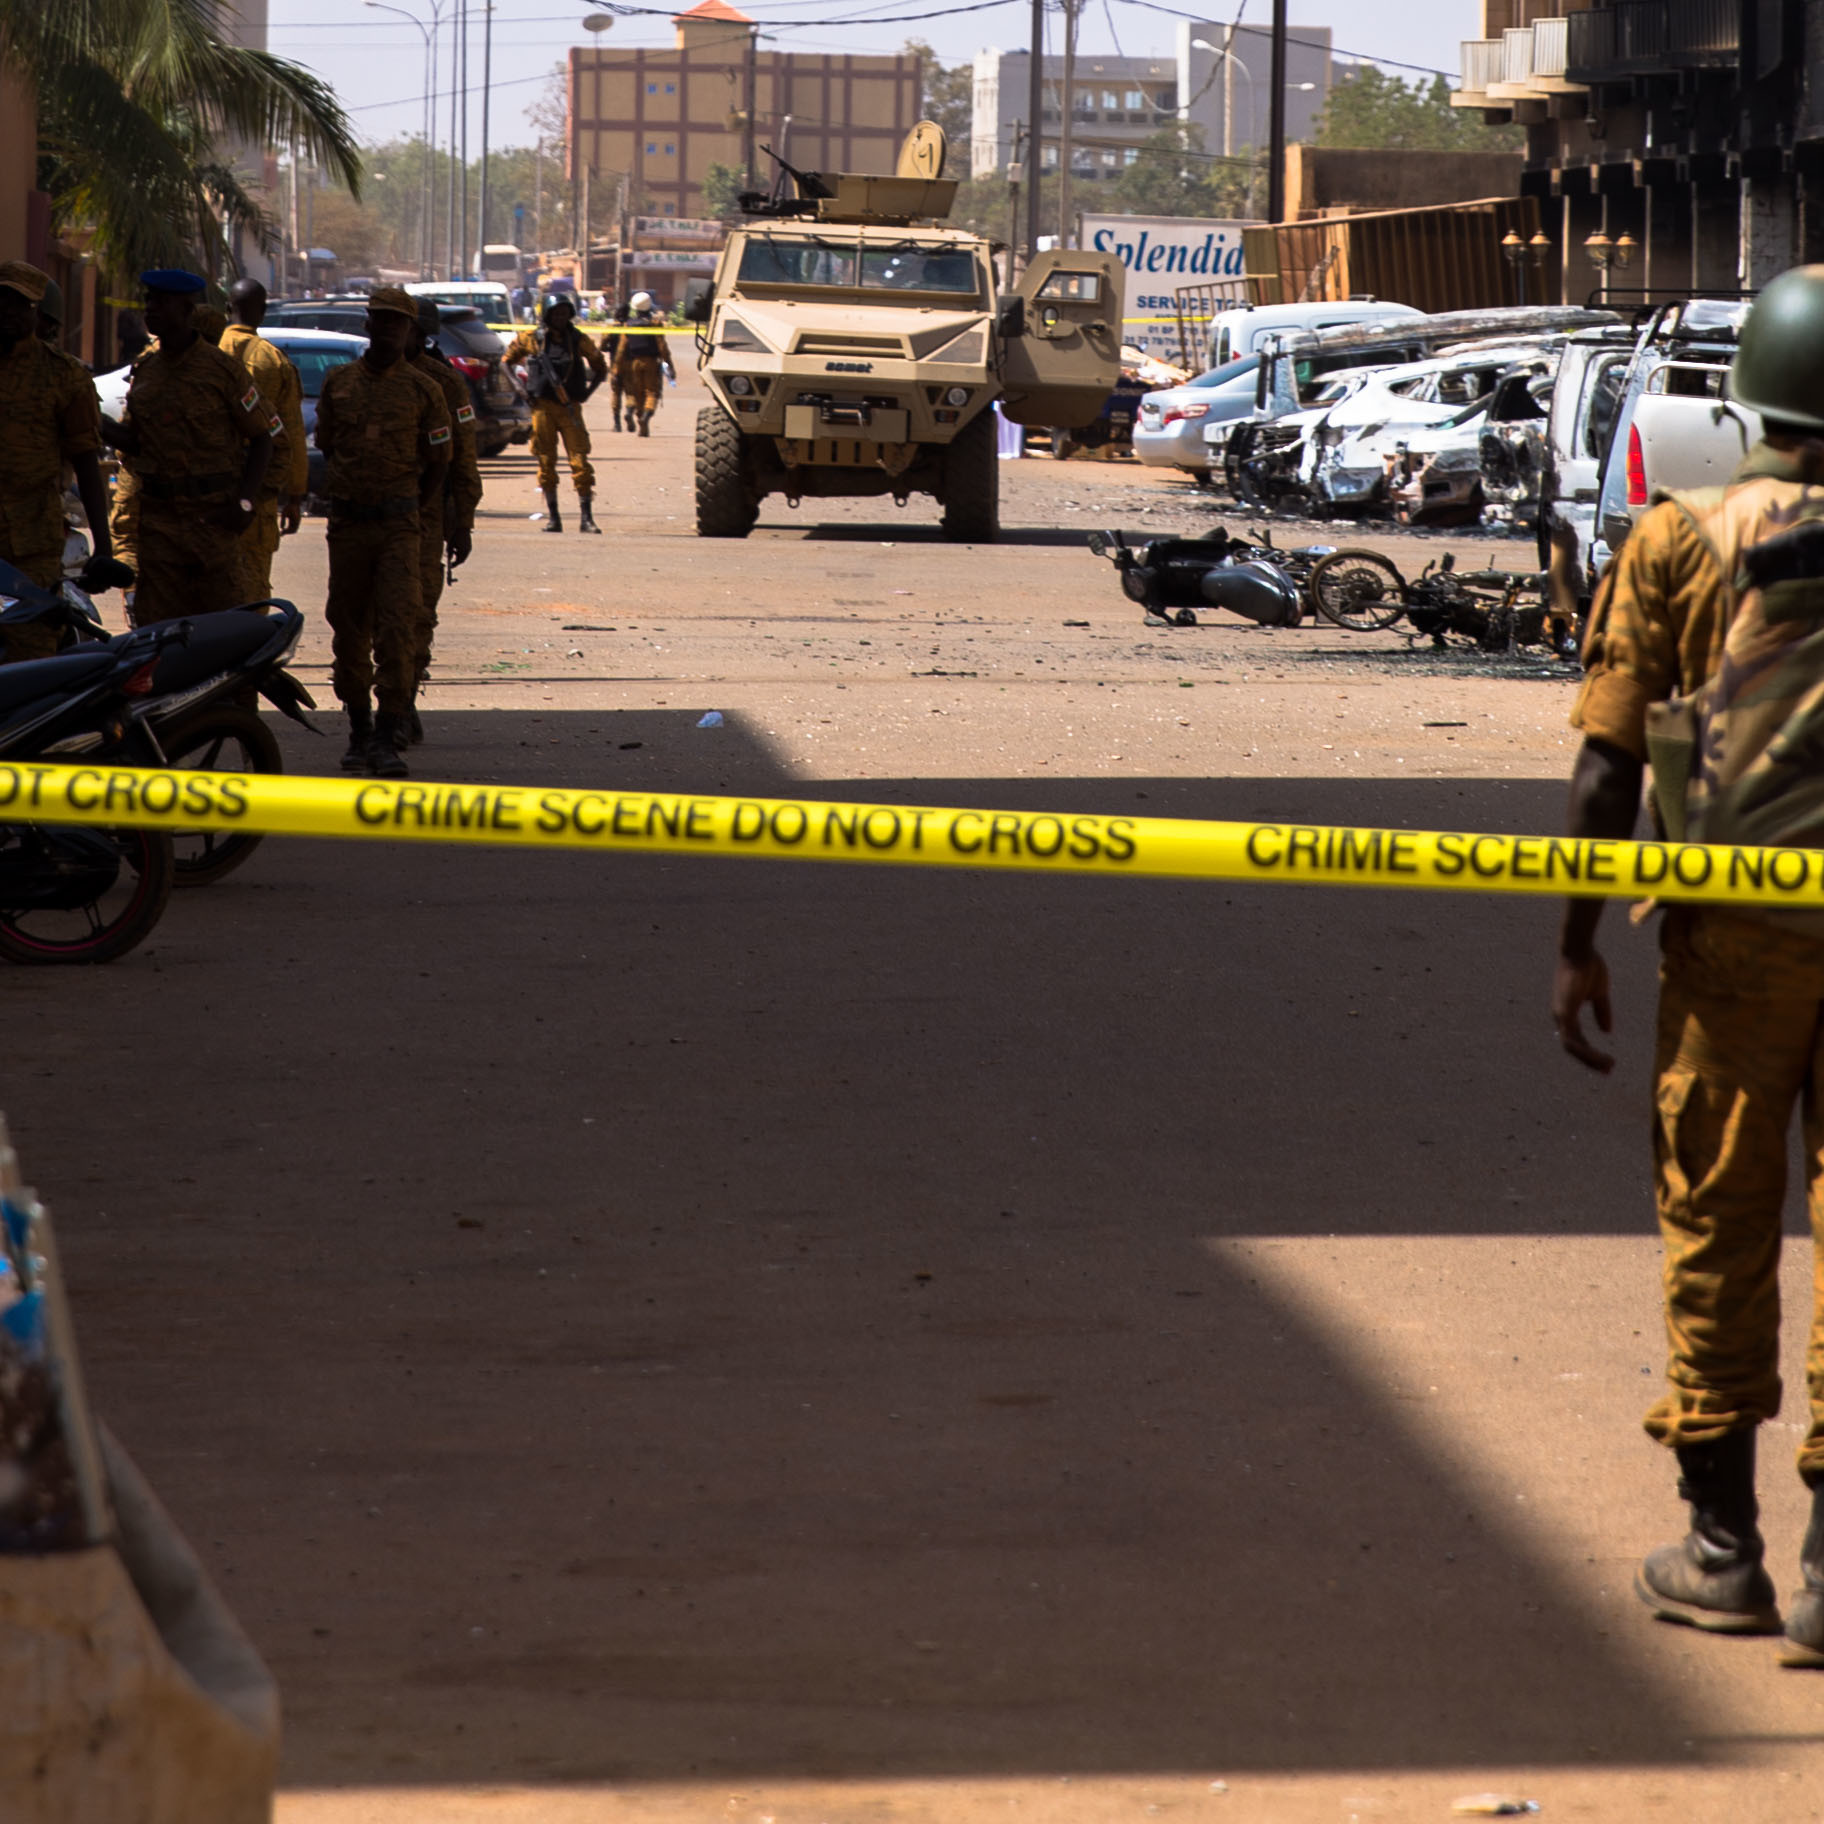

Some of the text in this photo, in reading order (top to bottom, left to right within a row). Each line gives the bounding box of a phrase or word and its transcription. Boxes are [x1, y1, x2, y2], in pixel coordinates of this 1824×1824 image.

[66, 770, 249, 818] CROSS
[355, 783, 525, 831] CRIME
[536, 793, 716, 841] SCENE
[731, 802, 808, 845] DO
[823, 807, 935, 851] NOT
[948, 812, 1138, 861] CROSS
[1246, 825, 1421, 873] CRIME
[1432, 834, 1619, 882] SCENE
[1633, 842, 1713, 887] DO
